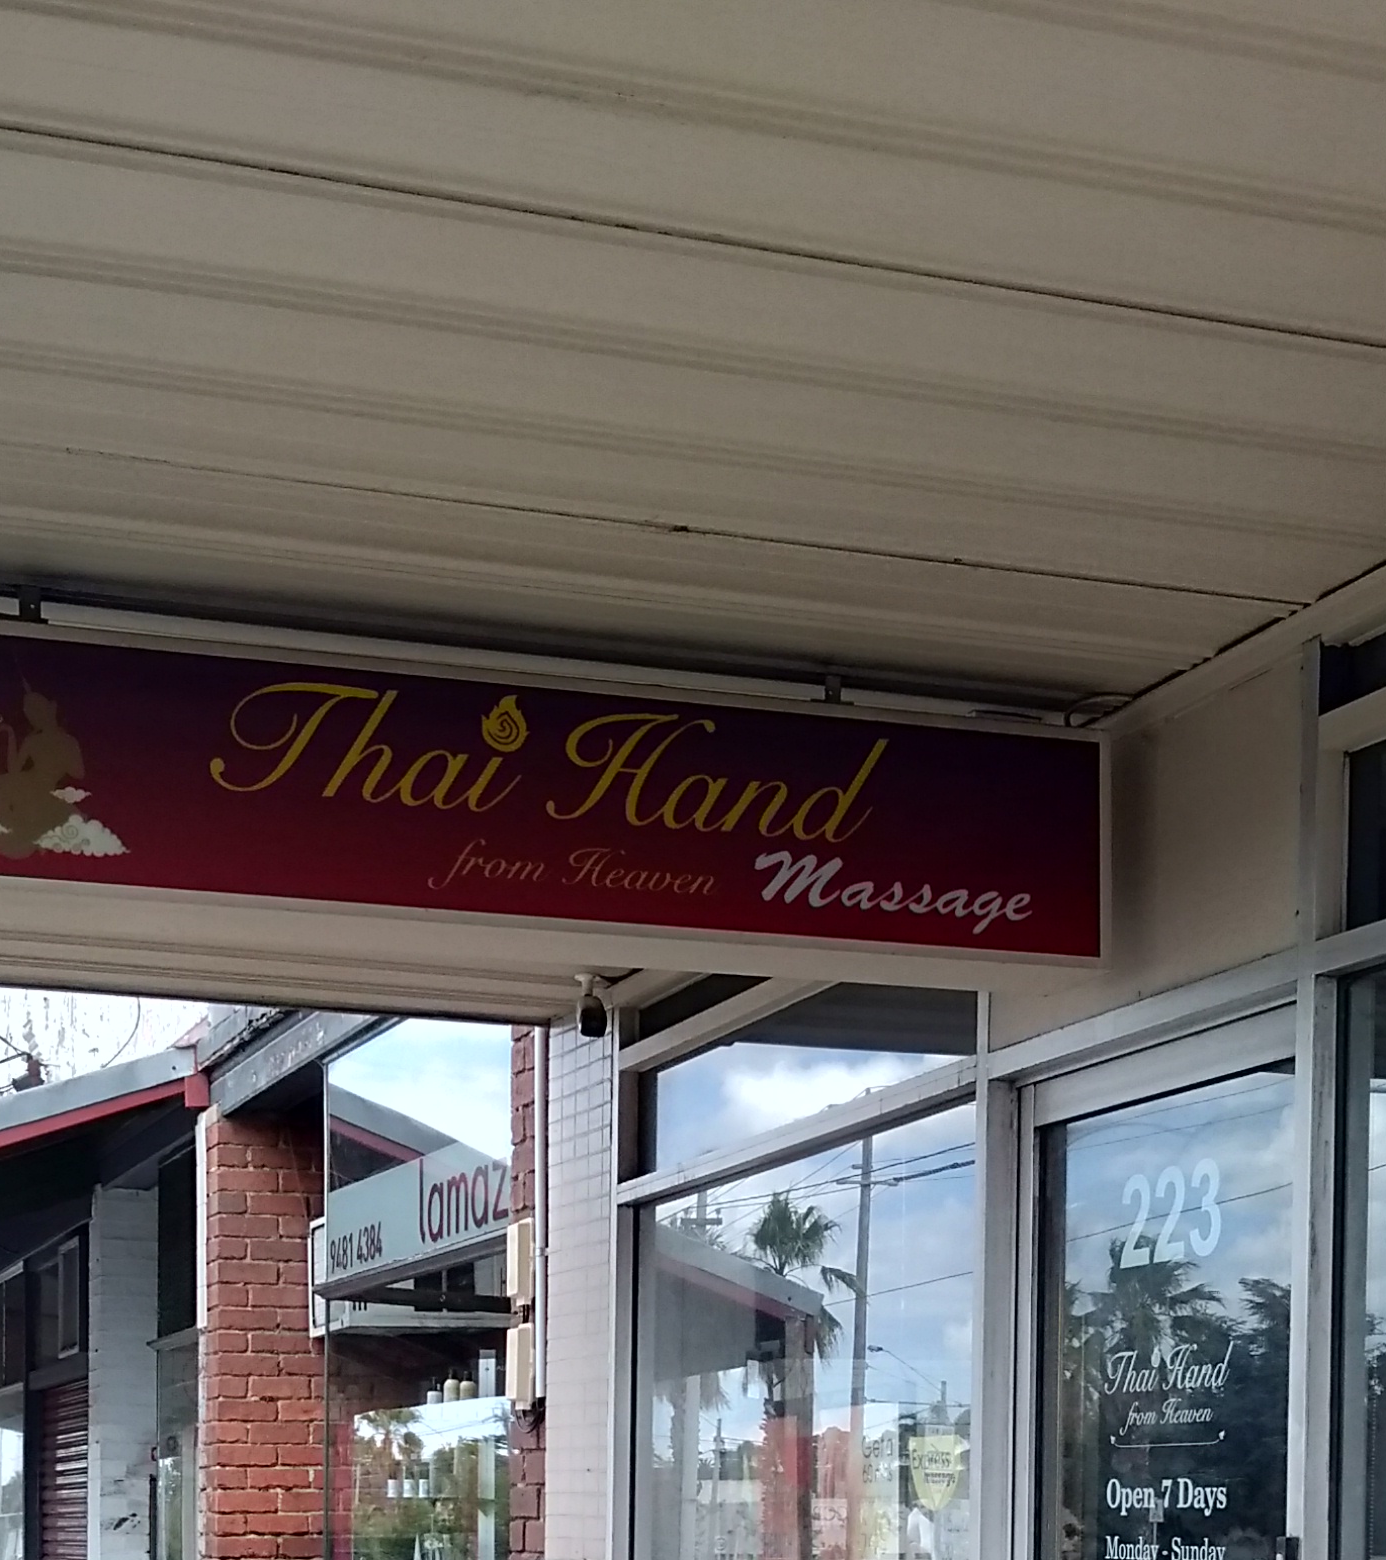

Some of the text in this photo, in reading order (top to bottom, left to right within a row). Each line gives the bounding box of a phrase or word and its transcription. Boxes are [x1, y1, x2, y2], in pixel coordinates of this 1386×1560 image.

[209, 680, 889, 846] Thai Hand
[427, 839, 718, 898] from Heaven
[754, 851, 1033, 937] Massage
[1119, 1157, 1223, 1269] 223
[330, 1221, 383, 1274] 9481 4384
[1104, 1340, 1235, 1396] Thai Hand
[1120, 1399, 1213, 1437] from Heaven
[1106, 1478, 1228, 1517] Open 7 Days
